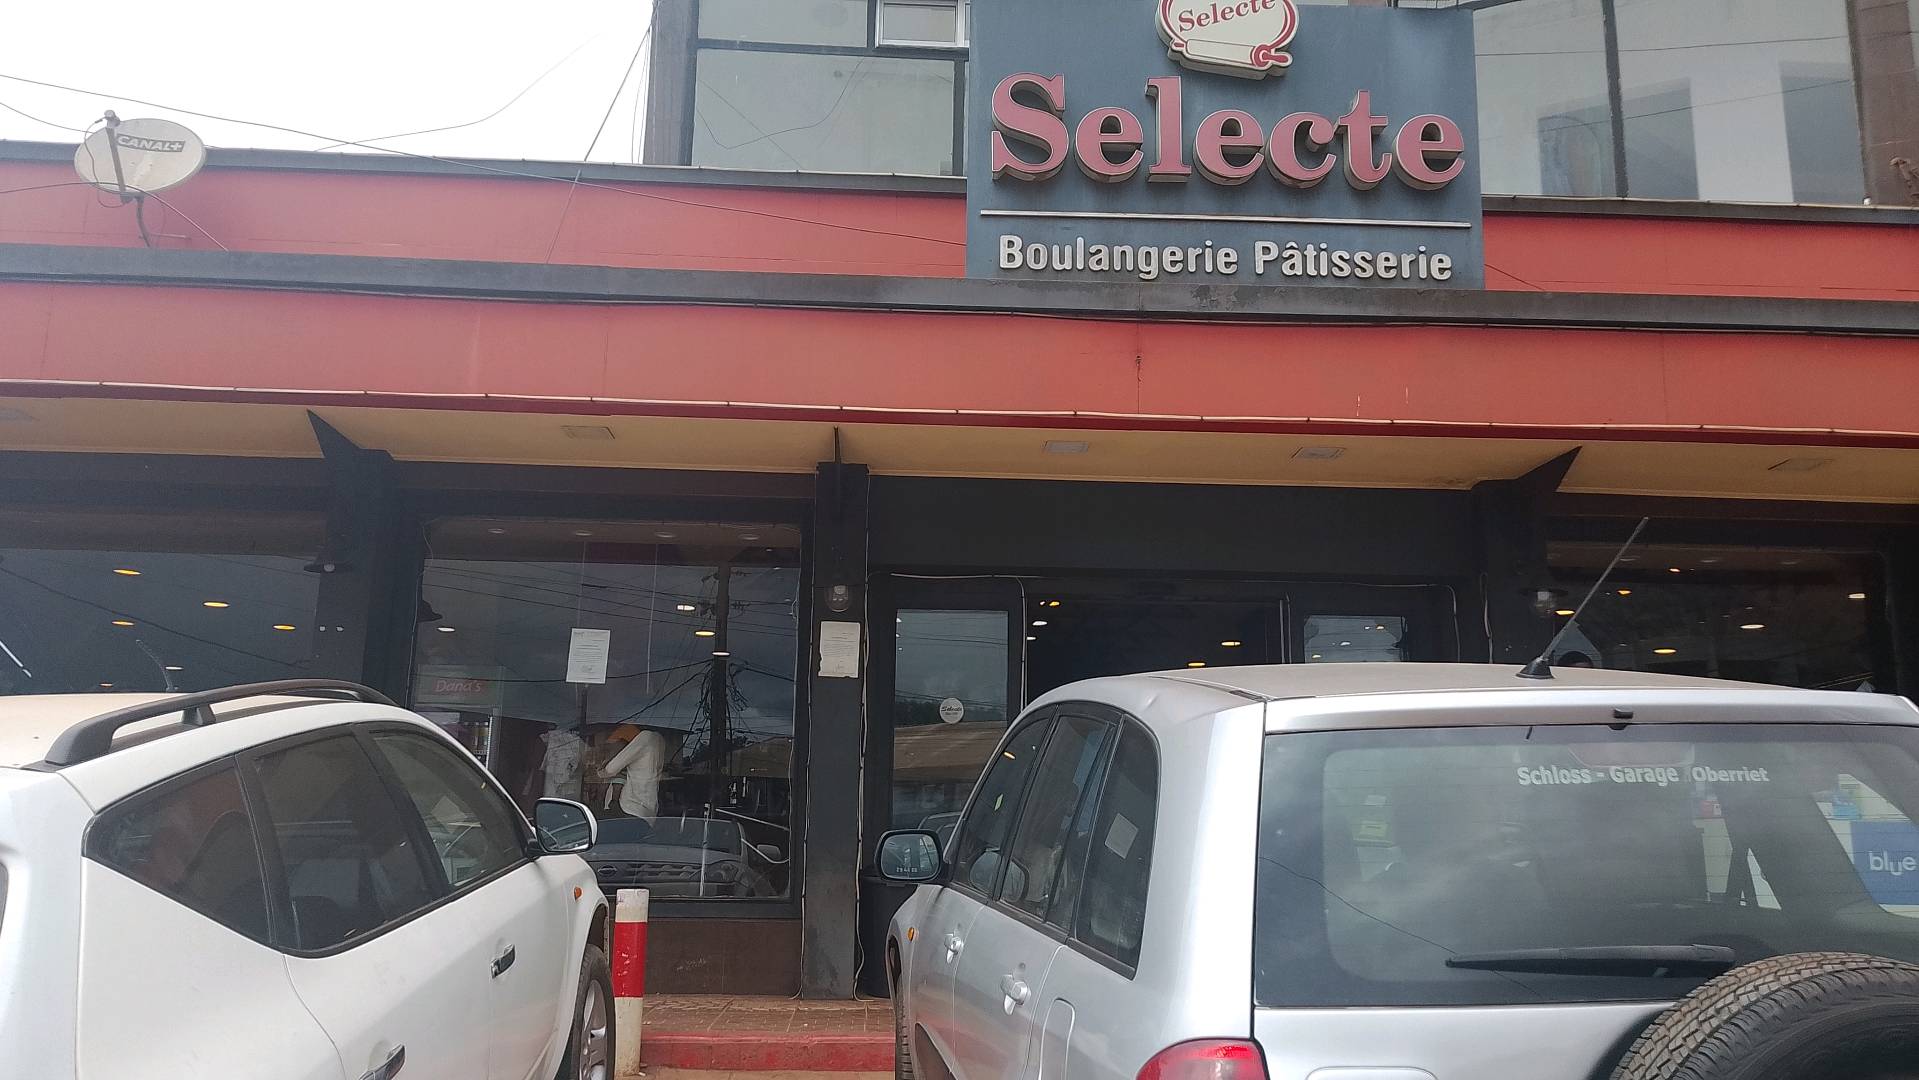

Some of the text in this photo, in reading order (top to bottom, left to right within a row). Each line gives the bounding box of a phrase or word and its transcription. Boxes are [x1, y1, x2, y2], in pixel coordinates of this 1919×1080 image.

[1178, 0, 1275, 32] Selecte
[118, 135, 183, 151] CANAL+
[991, 72, 1465, 188] Selecte
[999, 234, 1453, 281] Boulangerie Pâtisserie
[1517, 766, 1592, 785] Schloss
[1610, 766, 1680, 786] Garage
[1692, 767, 1770, 782] Oberriet
[1869, 851, 1917, 875] blue
